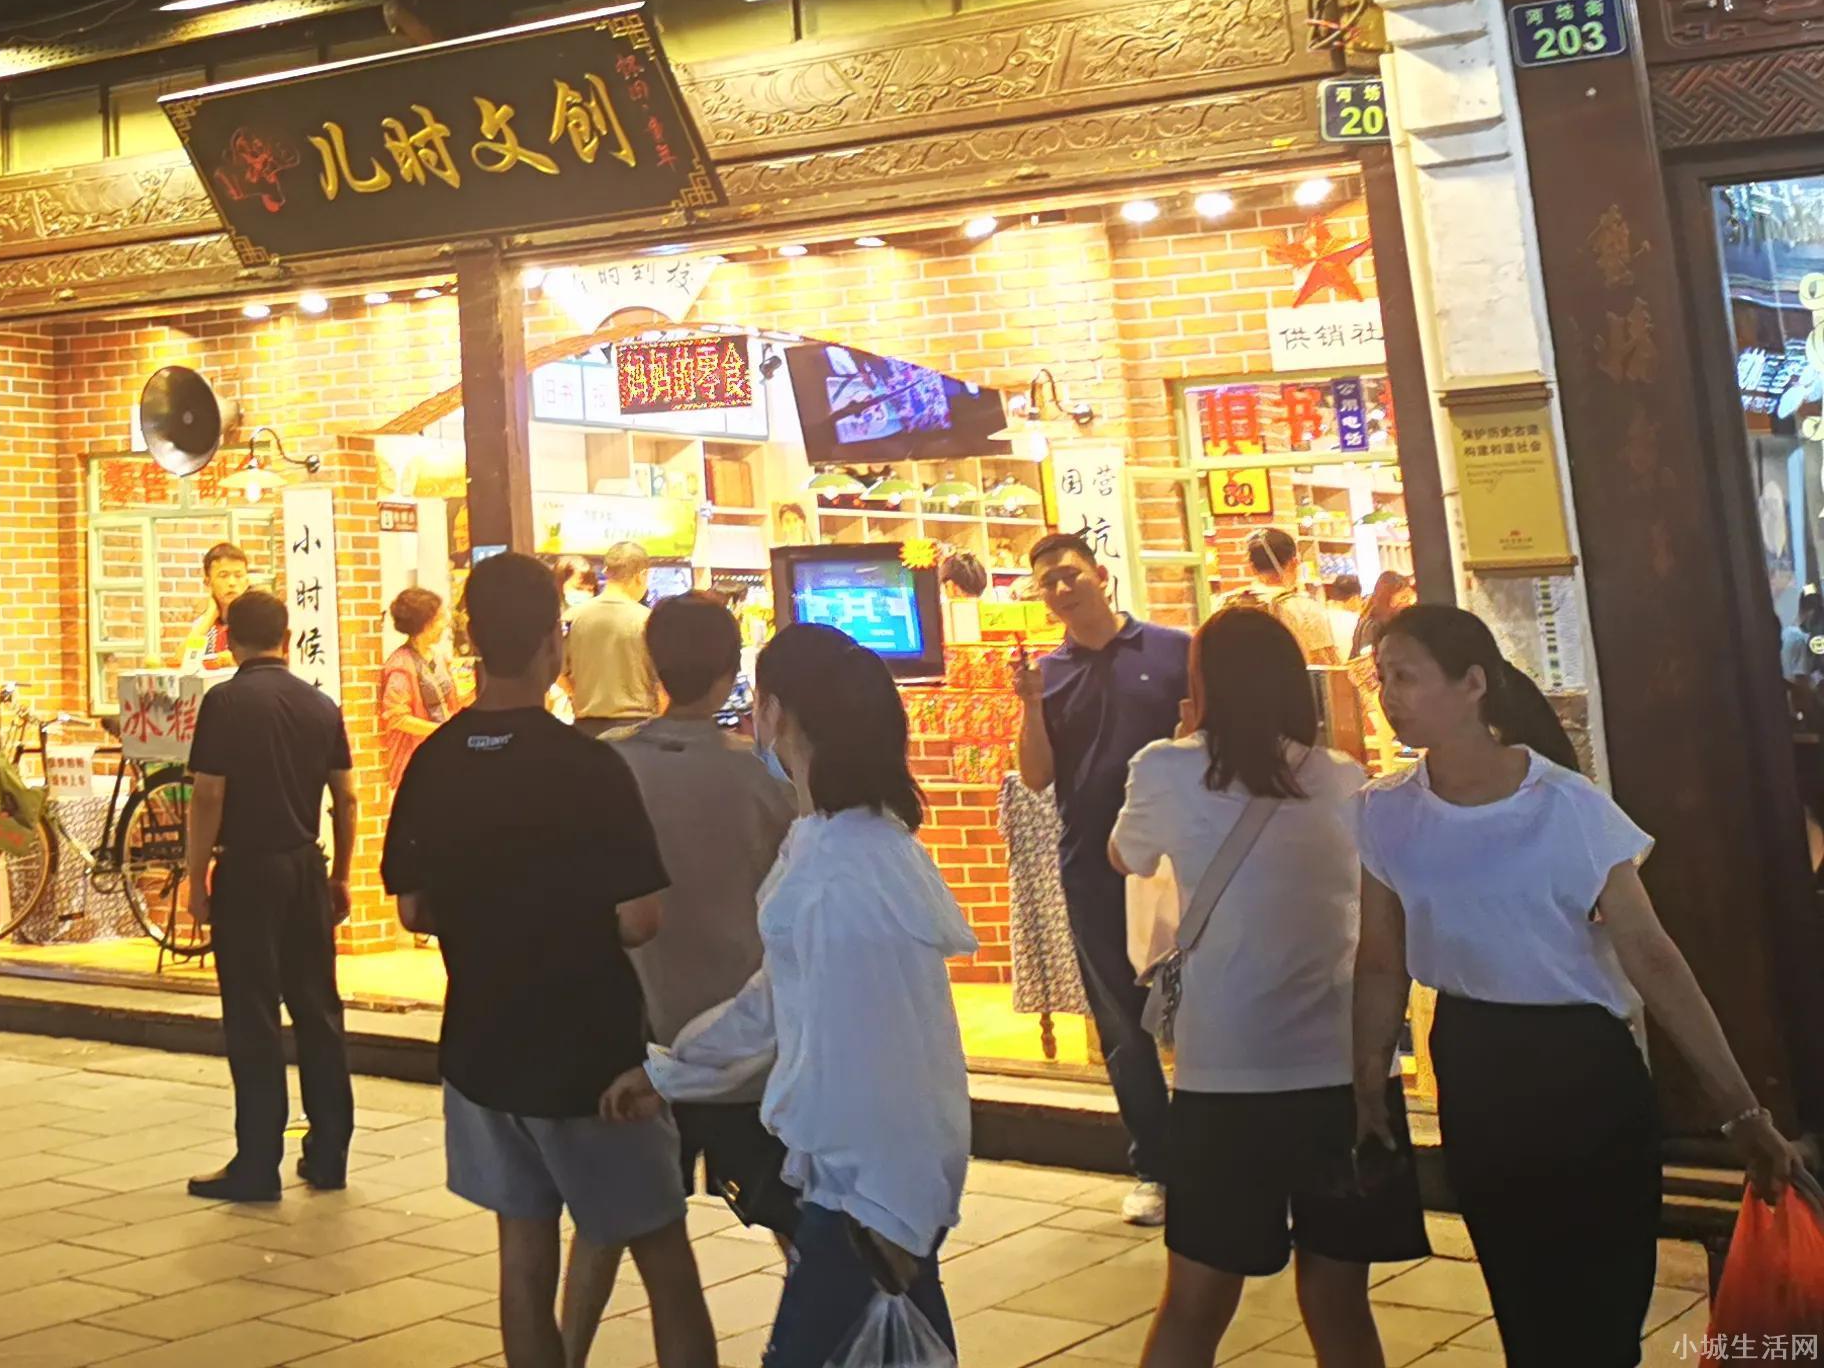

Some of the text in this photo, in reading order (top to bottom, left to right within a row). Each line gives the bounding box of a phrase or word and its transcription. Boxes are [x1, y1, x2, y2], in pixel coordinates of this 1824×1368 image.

[1534, 21, 1608, 60] 203
[1337, 84, 1382, 103] 河坊
[307, 73, 637, 202] 儿时文创
[1341, 105, 1384, 135] 20
[1279, 321, 1385, 351] 供销社
[1337, 382, 1364, 447] 公用电话
[1062, 464, 1116, 497] 国营
[292, 524, 326, 689] 小时候
